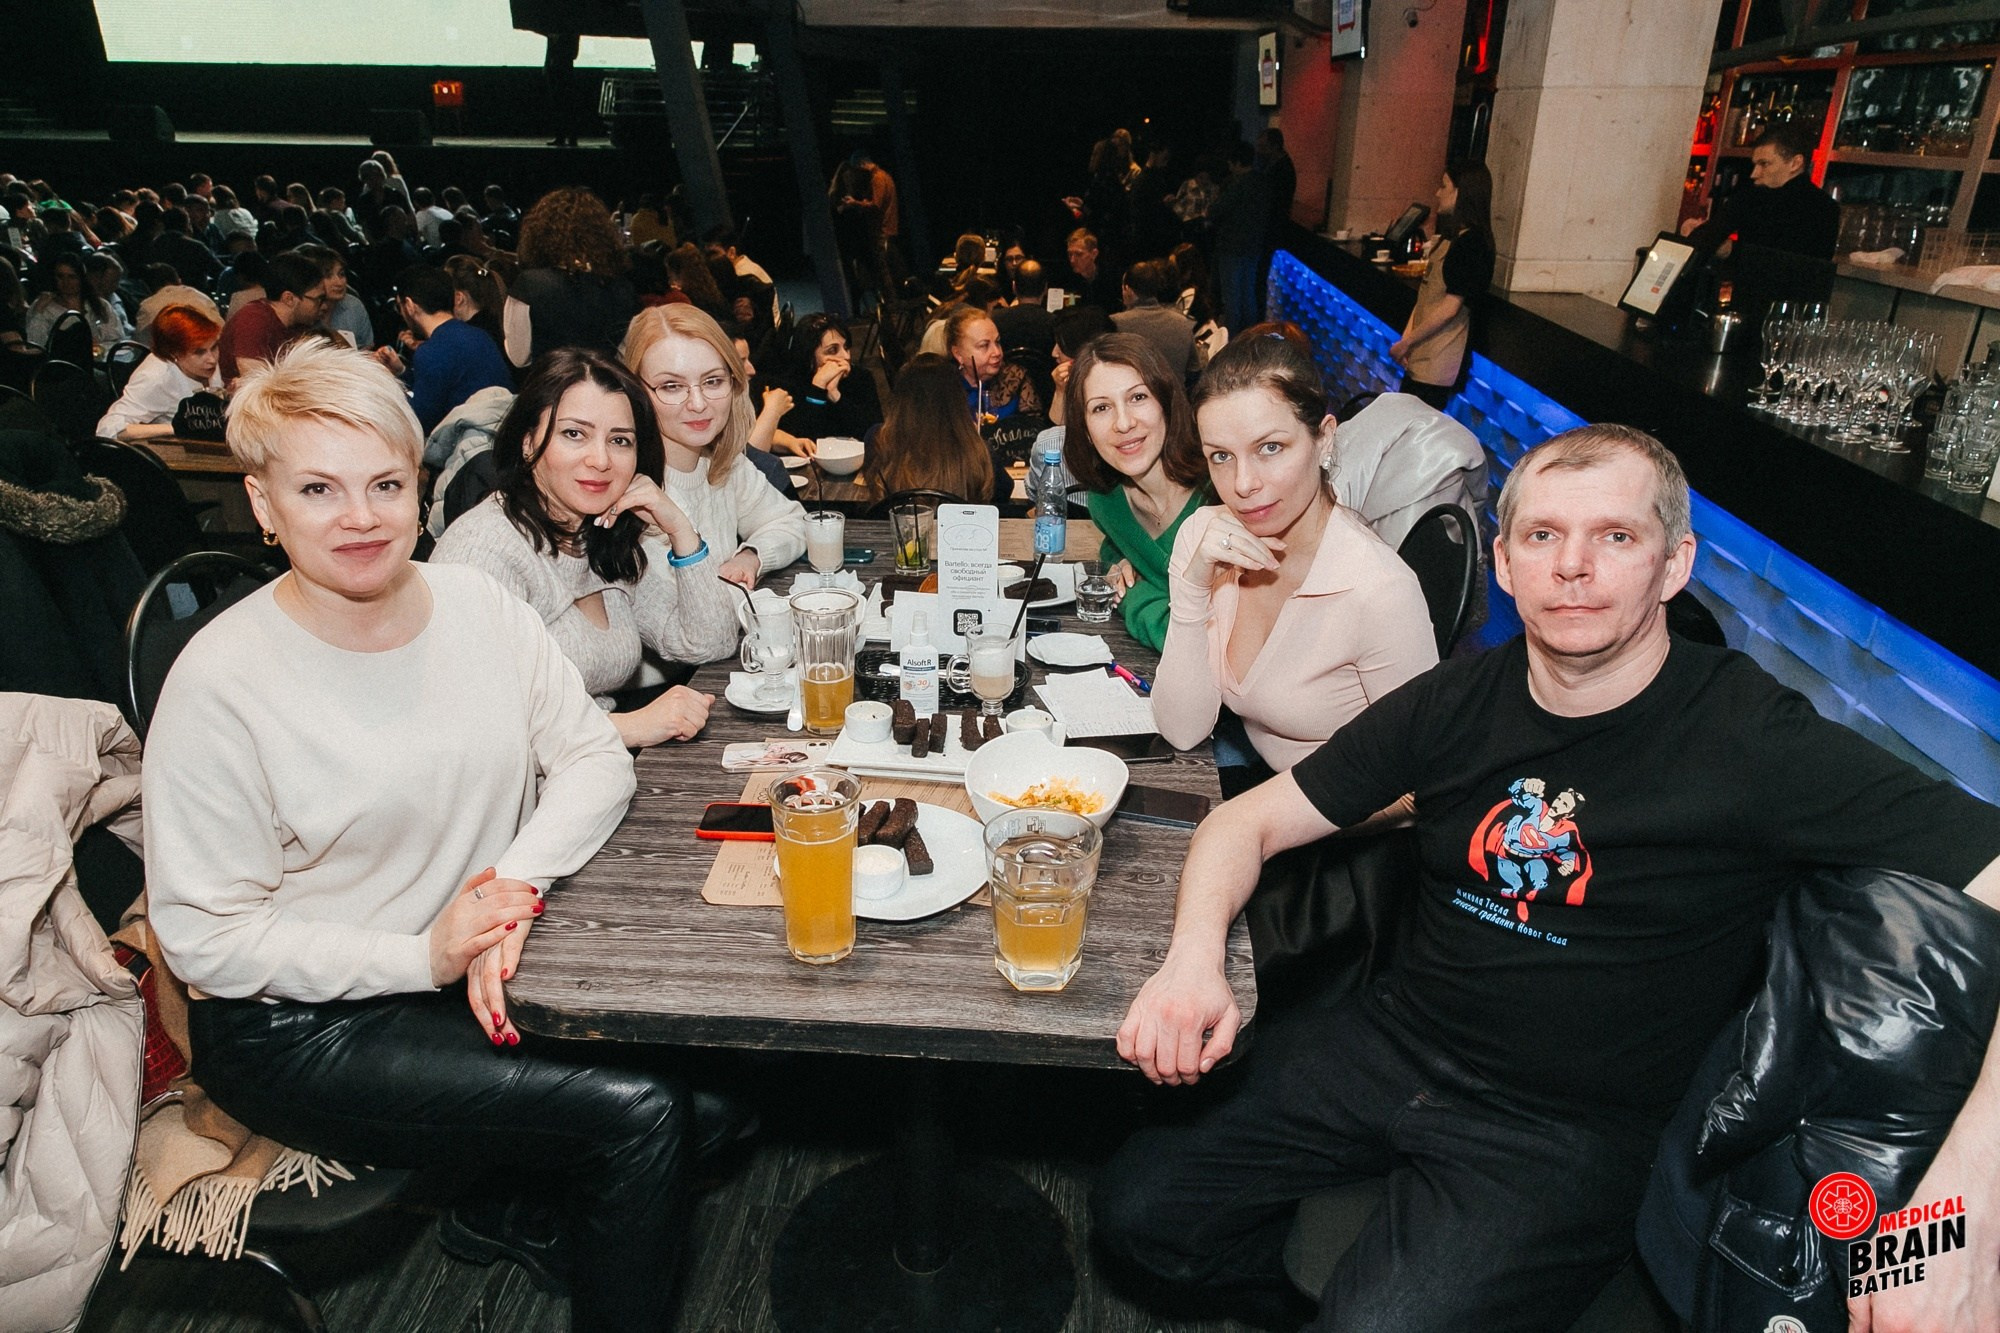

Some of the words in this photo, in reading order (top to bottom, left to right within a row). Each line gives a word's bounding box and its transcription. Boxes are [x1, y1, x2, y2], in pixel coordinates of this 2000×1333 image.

[950, 567, 987, 575] свободный
[1485, 897, 1509, 917] Тесла
[1517, 922, 1542, 938] Новог
[1546, 932, 1568, 946] Сада
